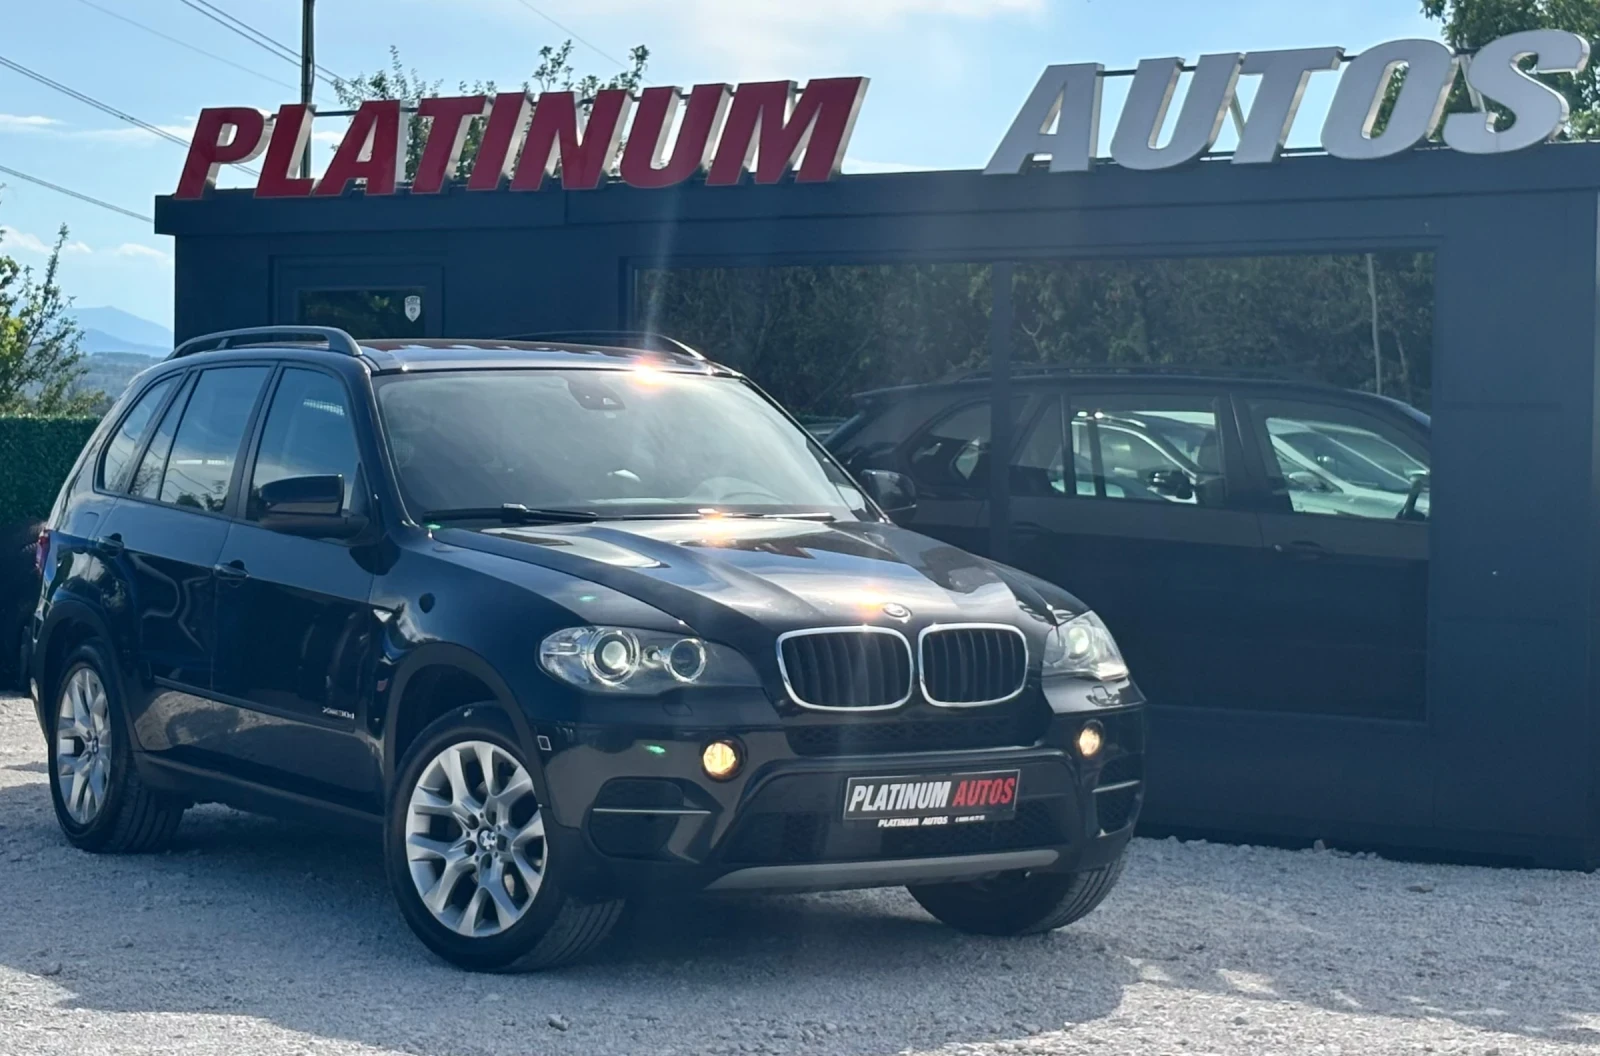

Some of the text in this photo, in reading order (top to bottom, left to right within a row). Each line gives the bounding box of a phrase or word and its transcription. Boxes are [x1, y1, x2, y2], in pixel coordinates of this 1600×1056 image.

[176, 29, 1589, 199] PLATINUM AUTOS
[848, 777, 1016, 812] PLATINUM AUTOS
[877, 817, 920, 828] PLATINUM
[921, 816, 949, 826] AUTOS
